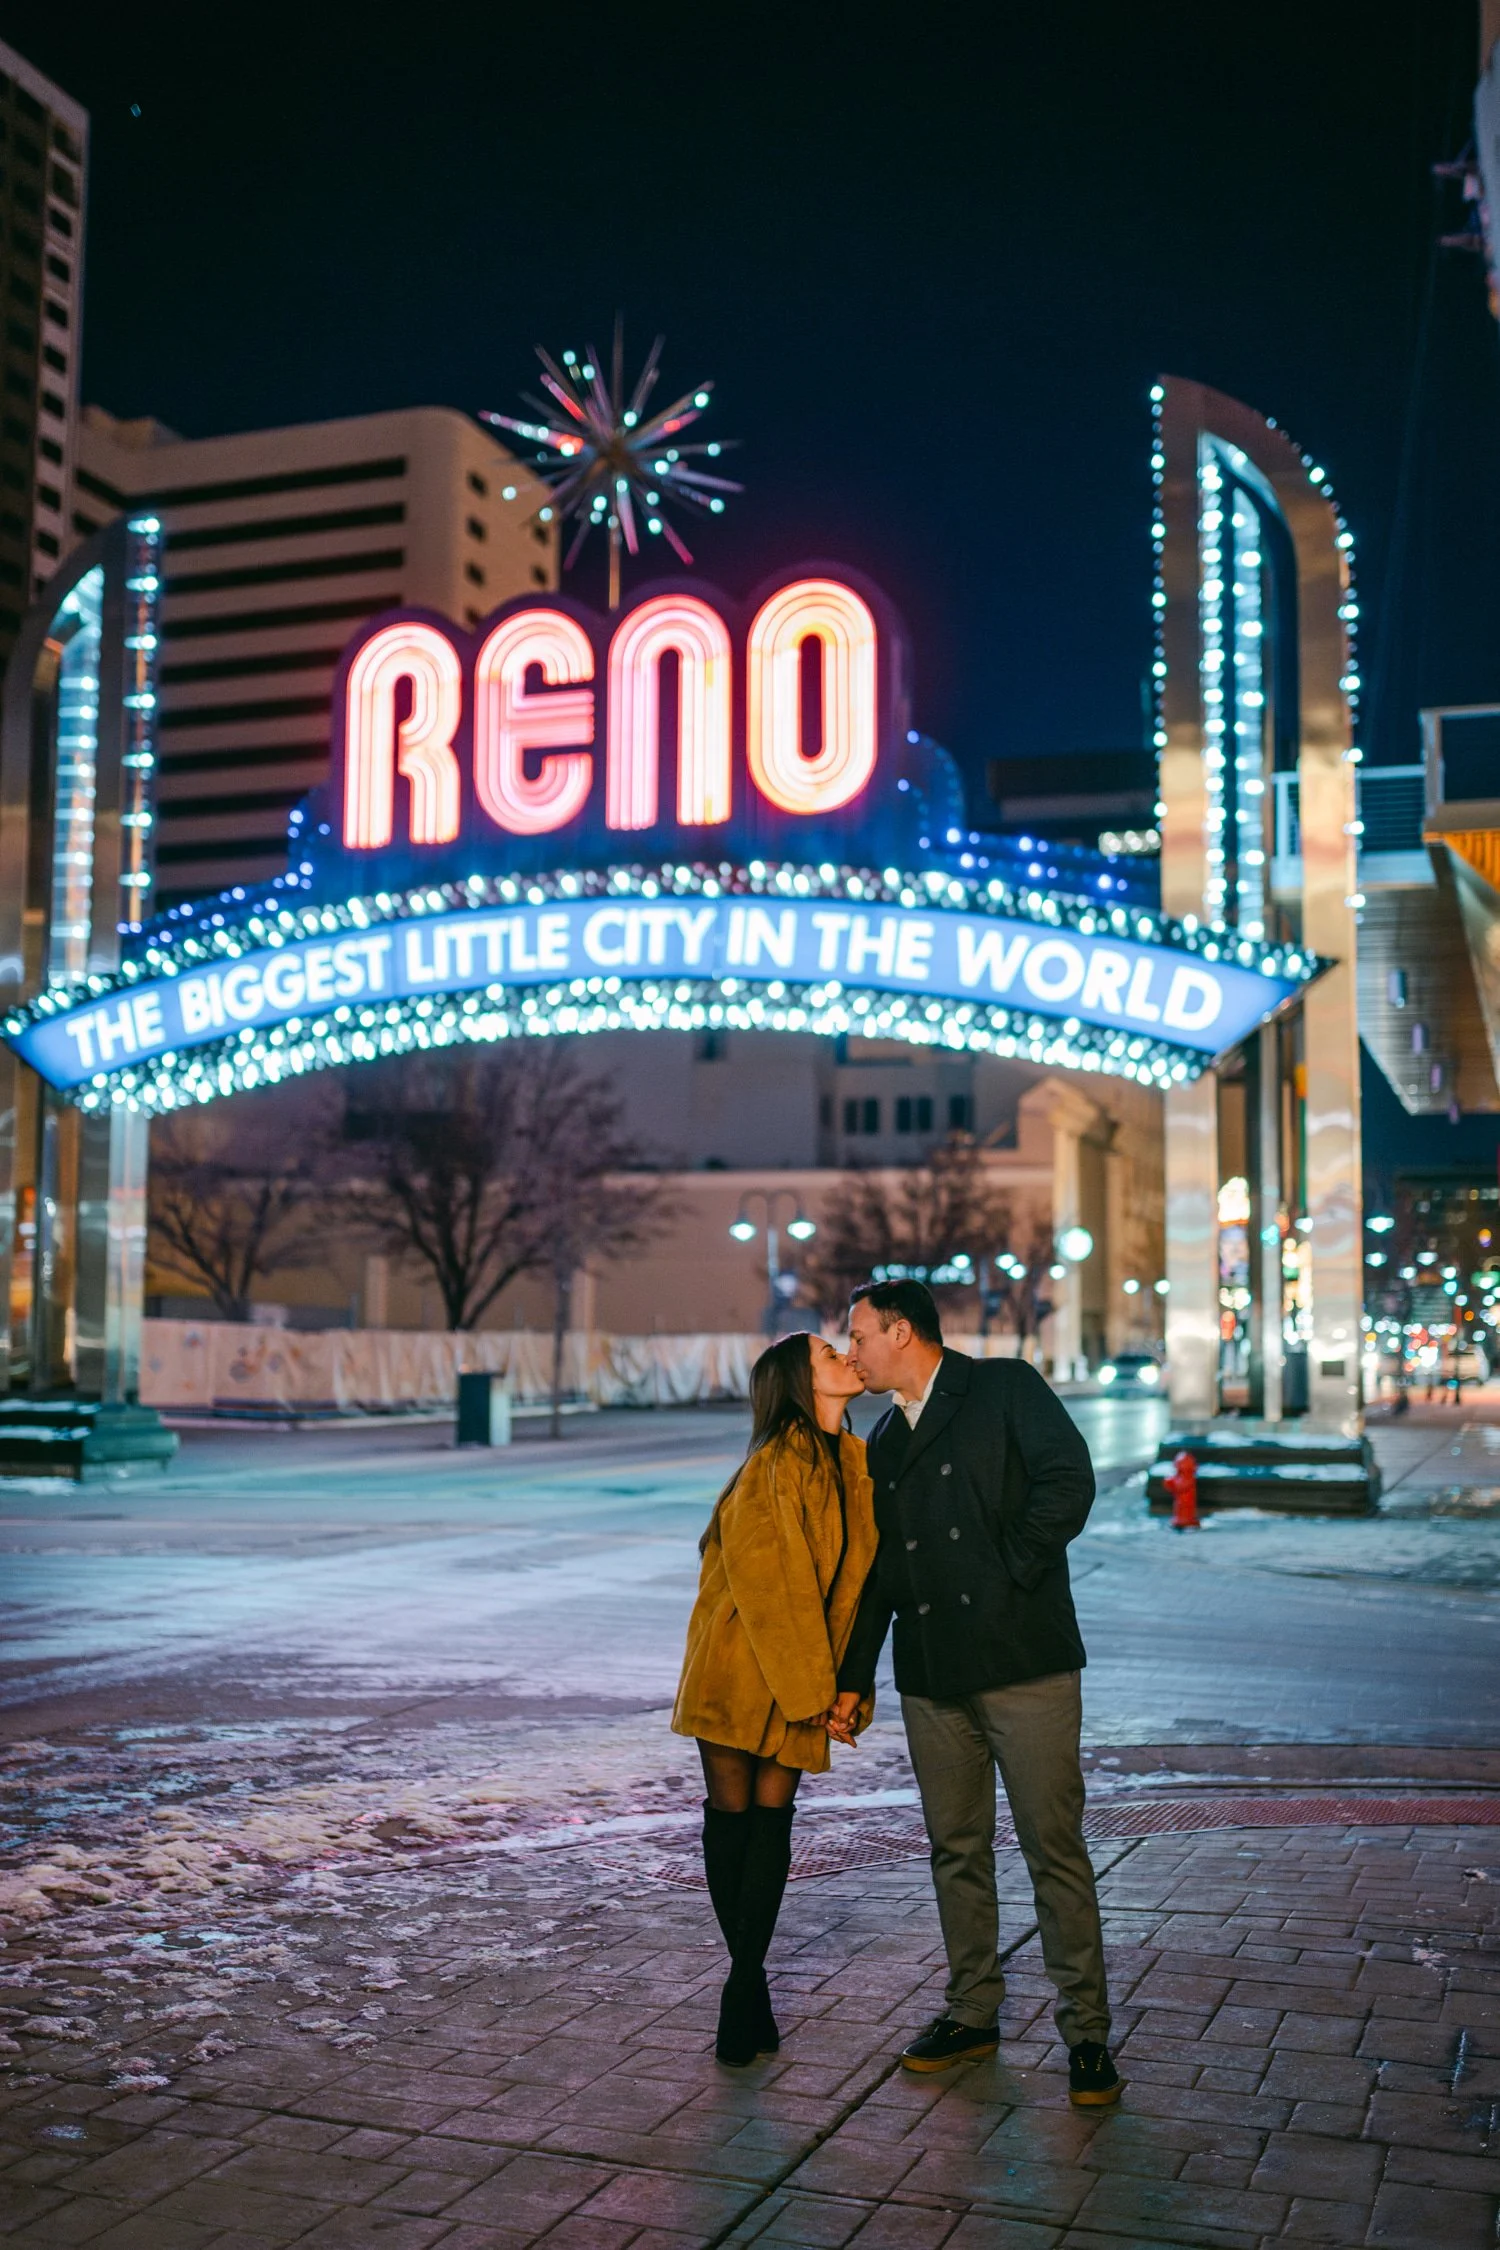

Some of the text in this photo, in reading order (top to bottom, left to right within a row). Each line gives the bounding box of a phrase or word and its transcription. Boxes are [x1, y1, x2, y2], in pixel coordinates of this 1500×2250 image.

[65, 906, 1224, 1070] THE BIGGEST LITTLE CITY IN THE WORLD
